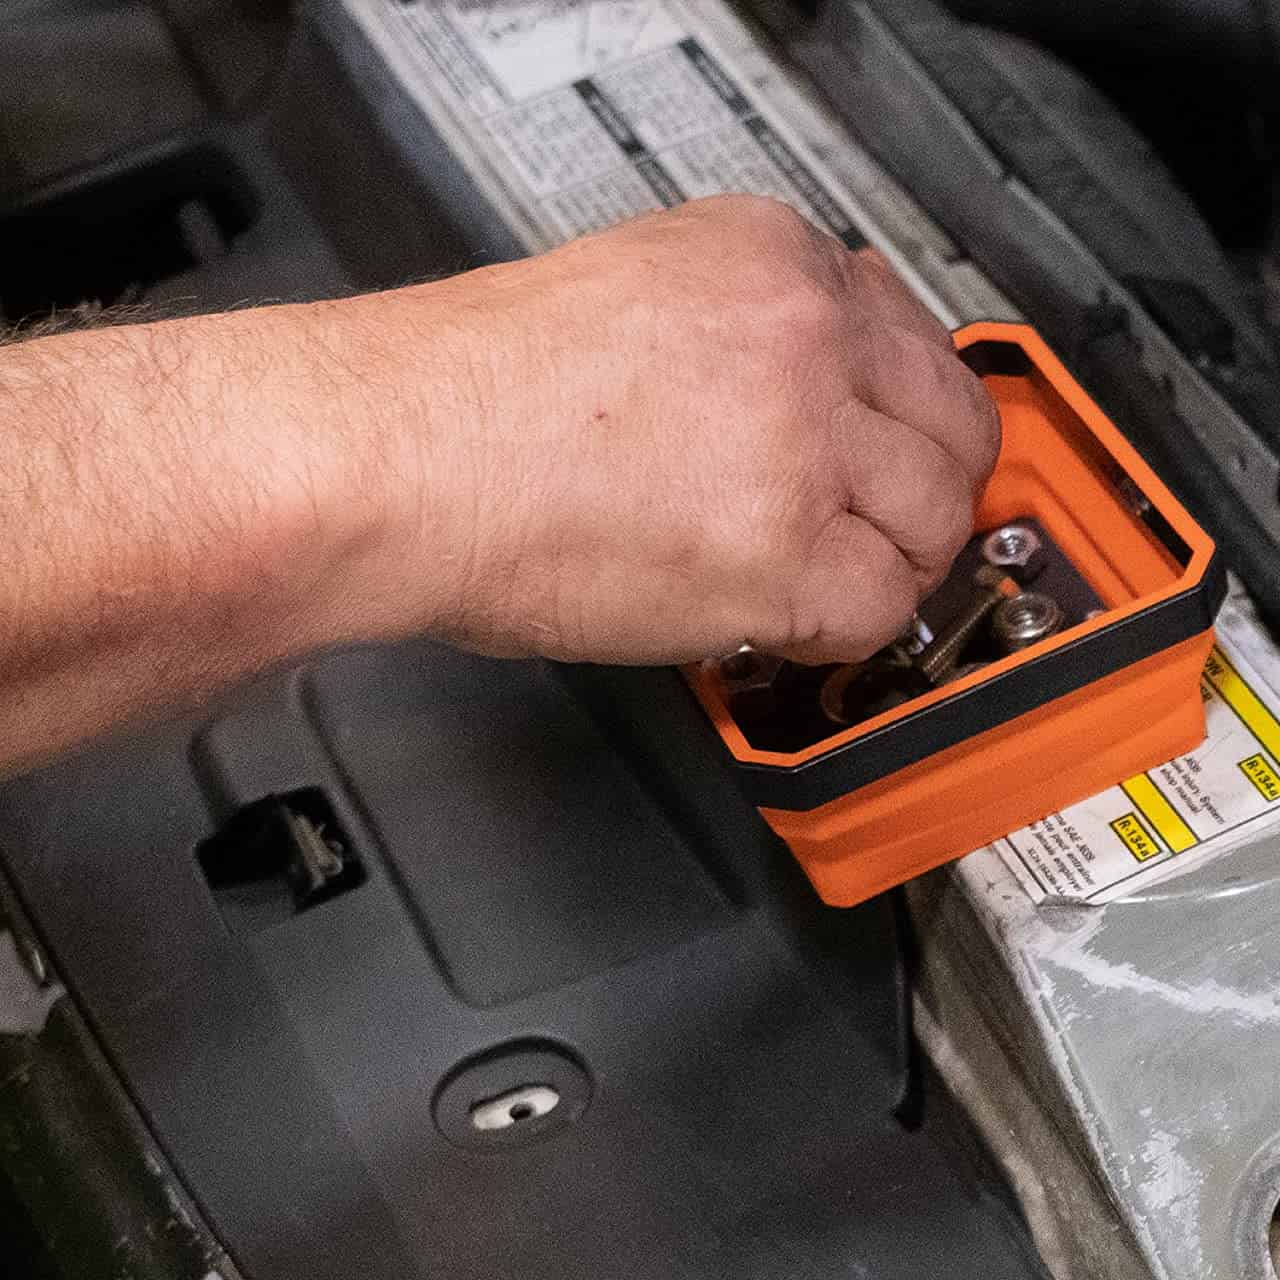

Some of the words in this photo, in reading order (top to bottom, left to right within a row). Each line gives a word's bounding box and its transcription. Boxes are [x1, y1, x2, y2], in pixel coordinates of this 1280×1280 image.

[1246, 759, 1279, 796] R-134a
[1198, 795, 1225, 825] System
[1117, 817, 1150, 857] R-134a
